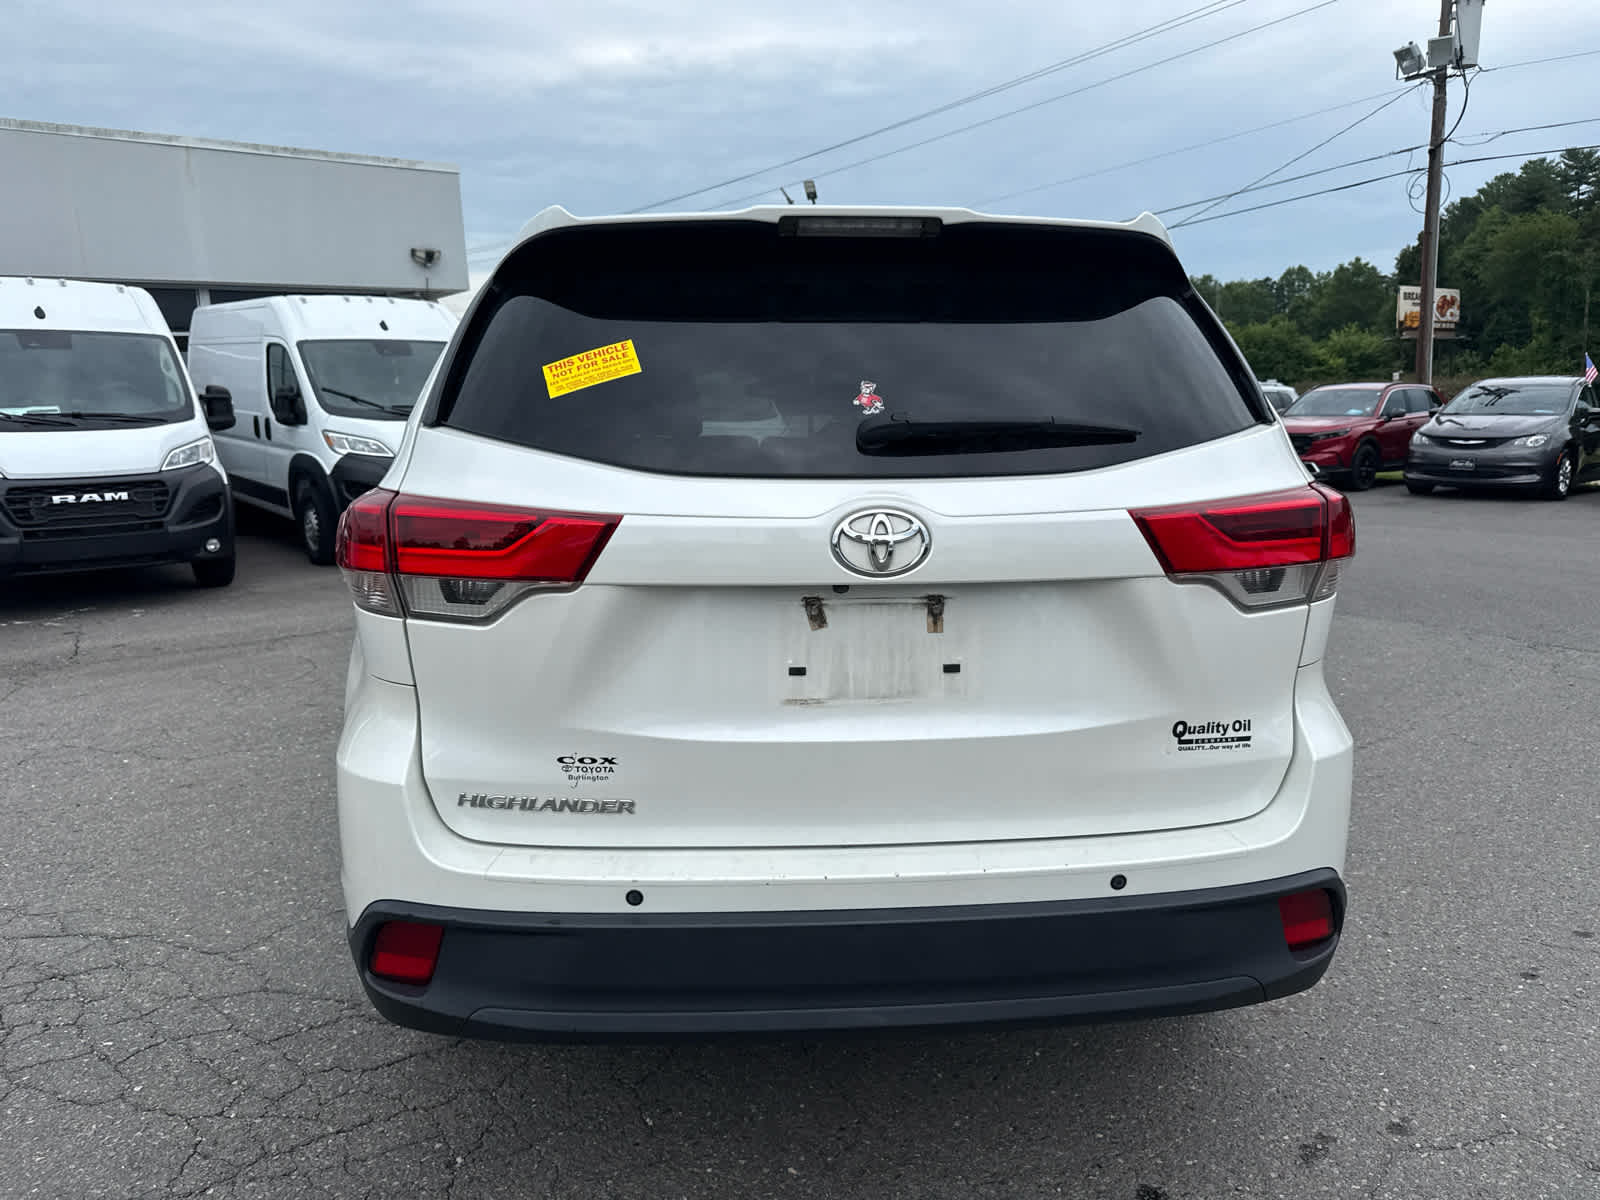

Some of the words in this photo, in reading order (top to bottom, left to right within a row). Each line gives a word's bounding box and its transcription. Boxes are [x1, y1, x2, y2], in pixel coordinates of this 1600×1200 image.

[547, 358, 575, 373] THIS
[577, 342, 630, 363] VEHICLE
[552, 368, 573, 379] NOT
[577, 360, 598, 371] FOR
[601, 352, 629, 364] SALE
[51, 491, 129, 504] RAM
[1172, 720, 1230, 738] Quality
[1232, 719, 1251, 732] Oil
[556, 756, 618, 765] COX
[575, 765, 615, 774] TOYOTA
[567, 774, 609, 782] Burlington
[457, 792, 636, 815] HIGHLANDER
